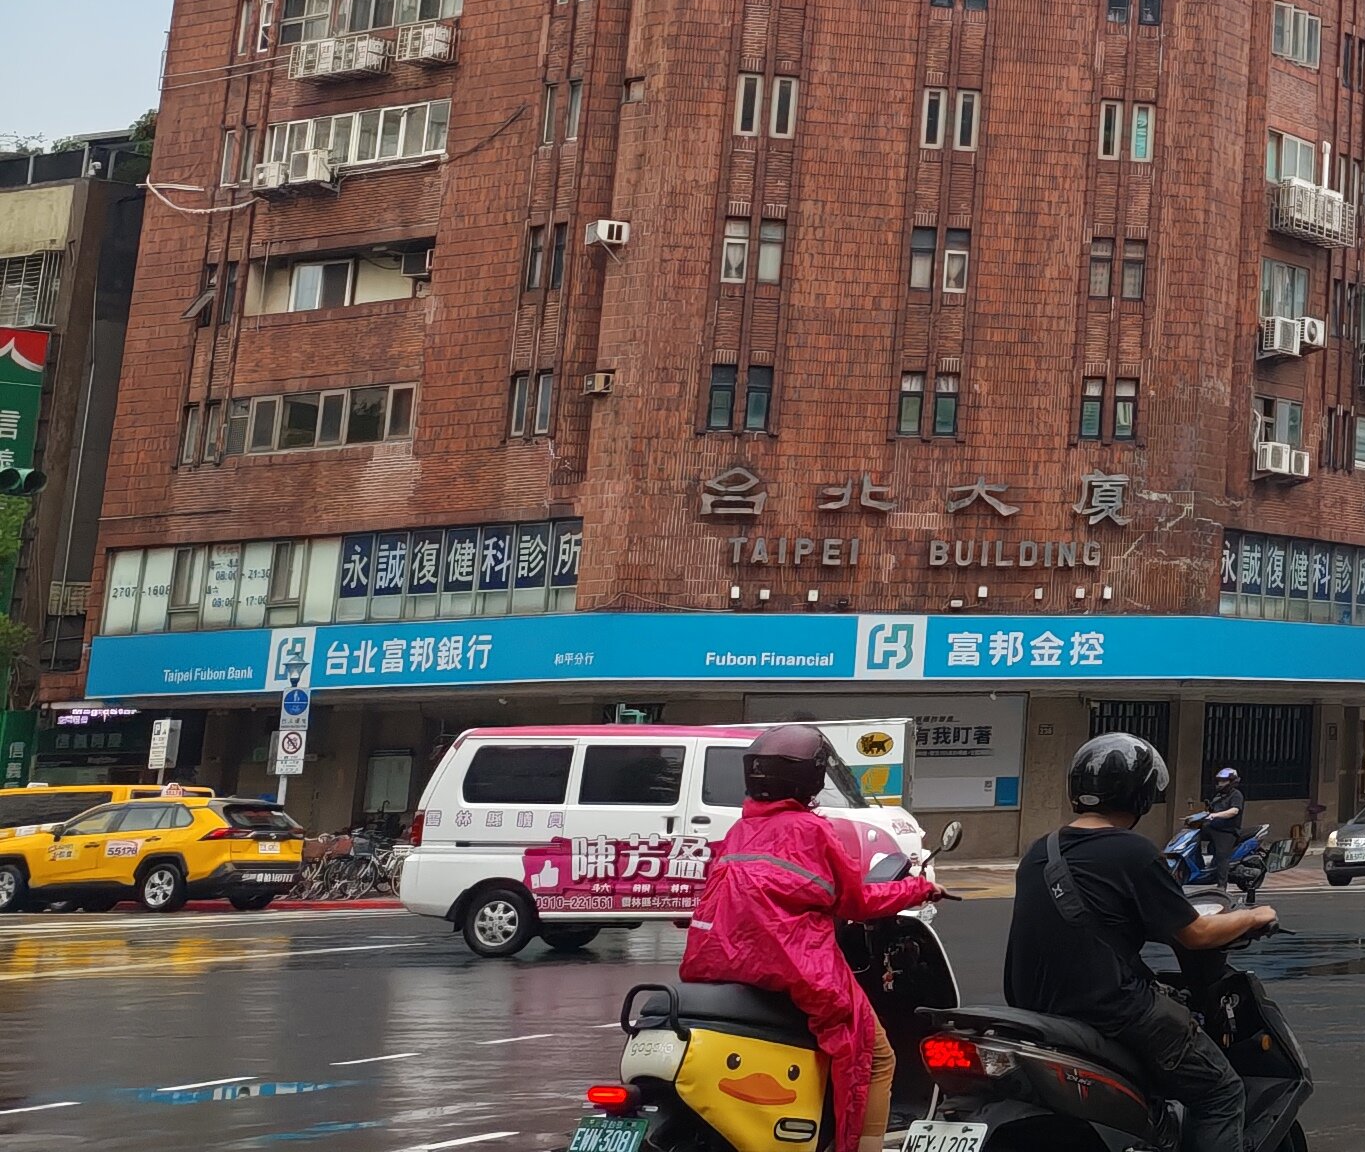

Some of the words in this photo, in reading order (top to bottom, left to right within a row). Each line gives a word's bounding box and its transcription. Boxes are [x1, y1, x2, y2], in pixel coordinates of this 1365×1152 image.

[342, 532, 582, 589] 永誠復健科診所
[728, 536, 860, 566] TAIPEI
[929, 539, 1100, 567] BUILDING
[325, 634, 493, 675] 台北富邦銀行
[553, 652, 595, 667] 和平分行
[706, 651, 758, 667] Fubon
[761, 652, 834, 667] Financial
[947, 629, 1106, 667] 富邦金控
[163, 668, 193, 684] Taipei
[194, 666, 226, 681] Fubon
[227, 665, 253, 680] Bank
[570, 833, 712, 882] 陳芳盈
[536, 895, 614, 909] 0910-221561
